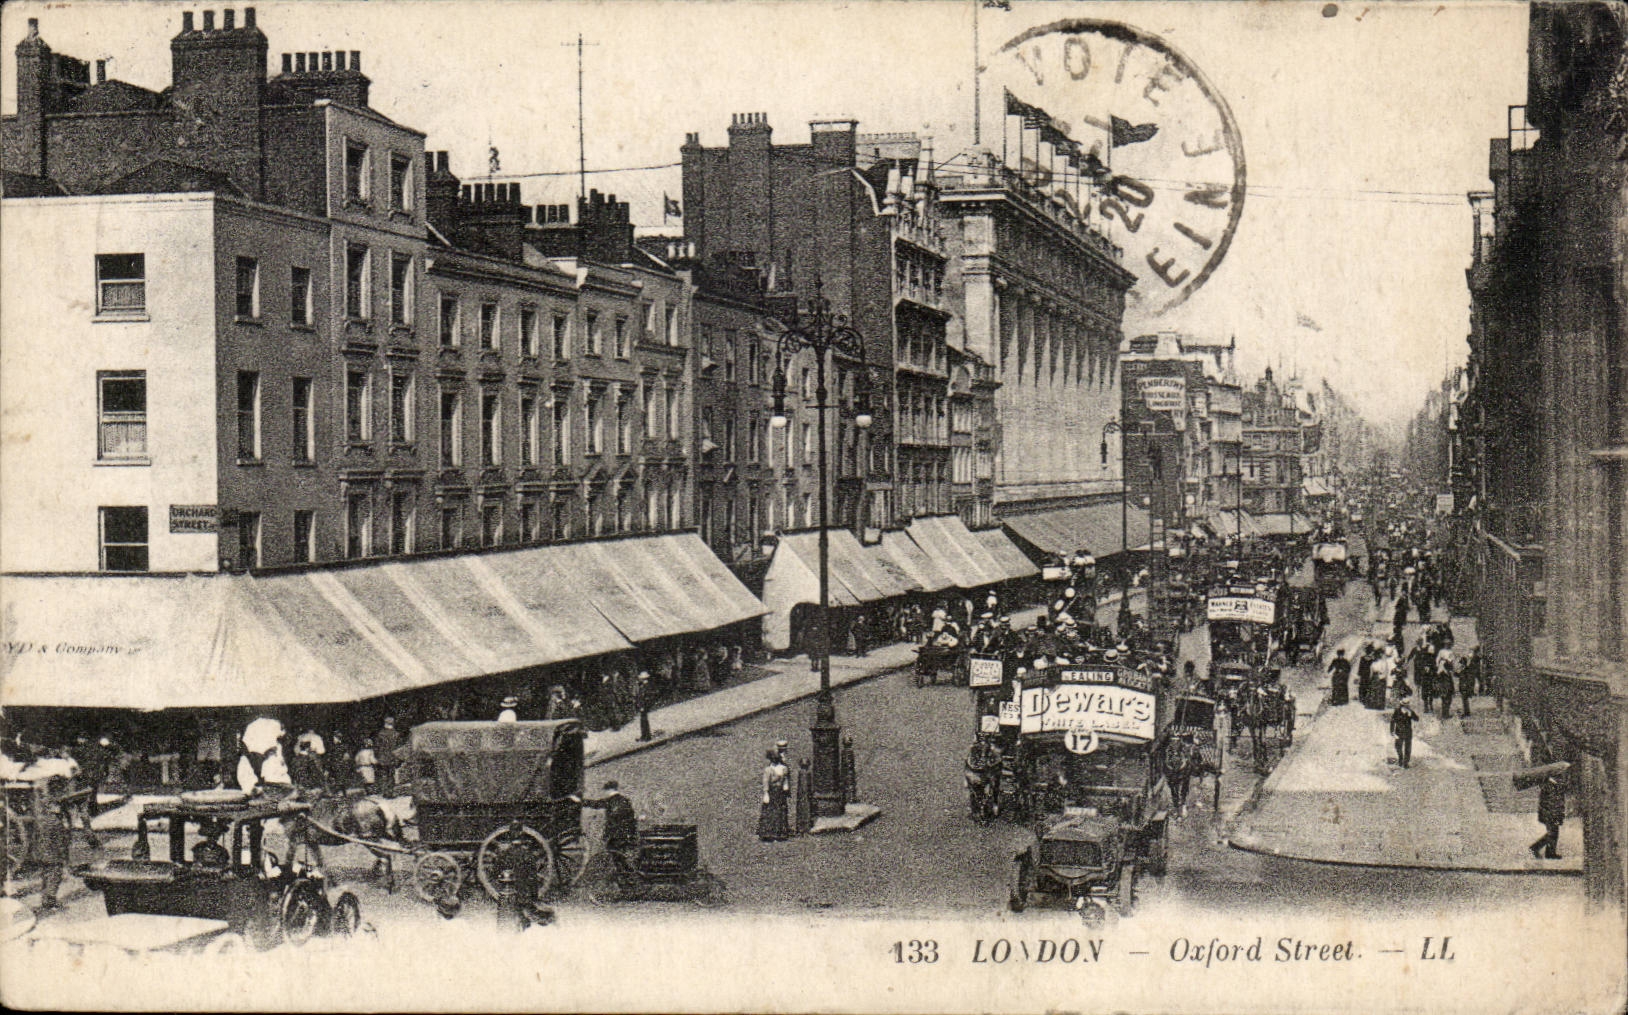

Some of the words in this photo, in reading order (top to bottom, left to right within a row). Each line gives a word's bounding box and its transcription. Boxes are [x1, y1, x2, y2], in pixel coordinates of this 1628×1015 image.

[170, 507, 217, 517] ORCHARD
[171, 519, 208, 529] STREET
[1071, 671, 1111, 681] EALING
[1072, 734, 1093, 751] 17
